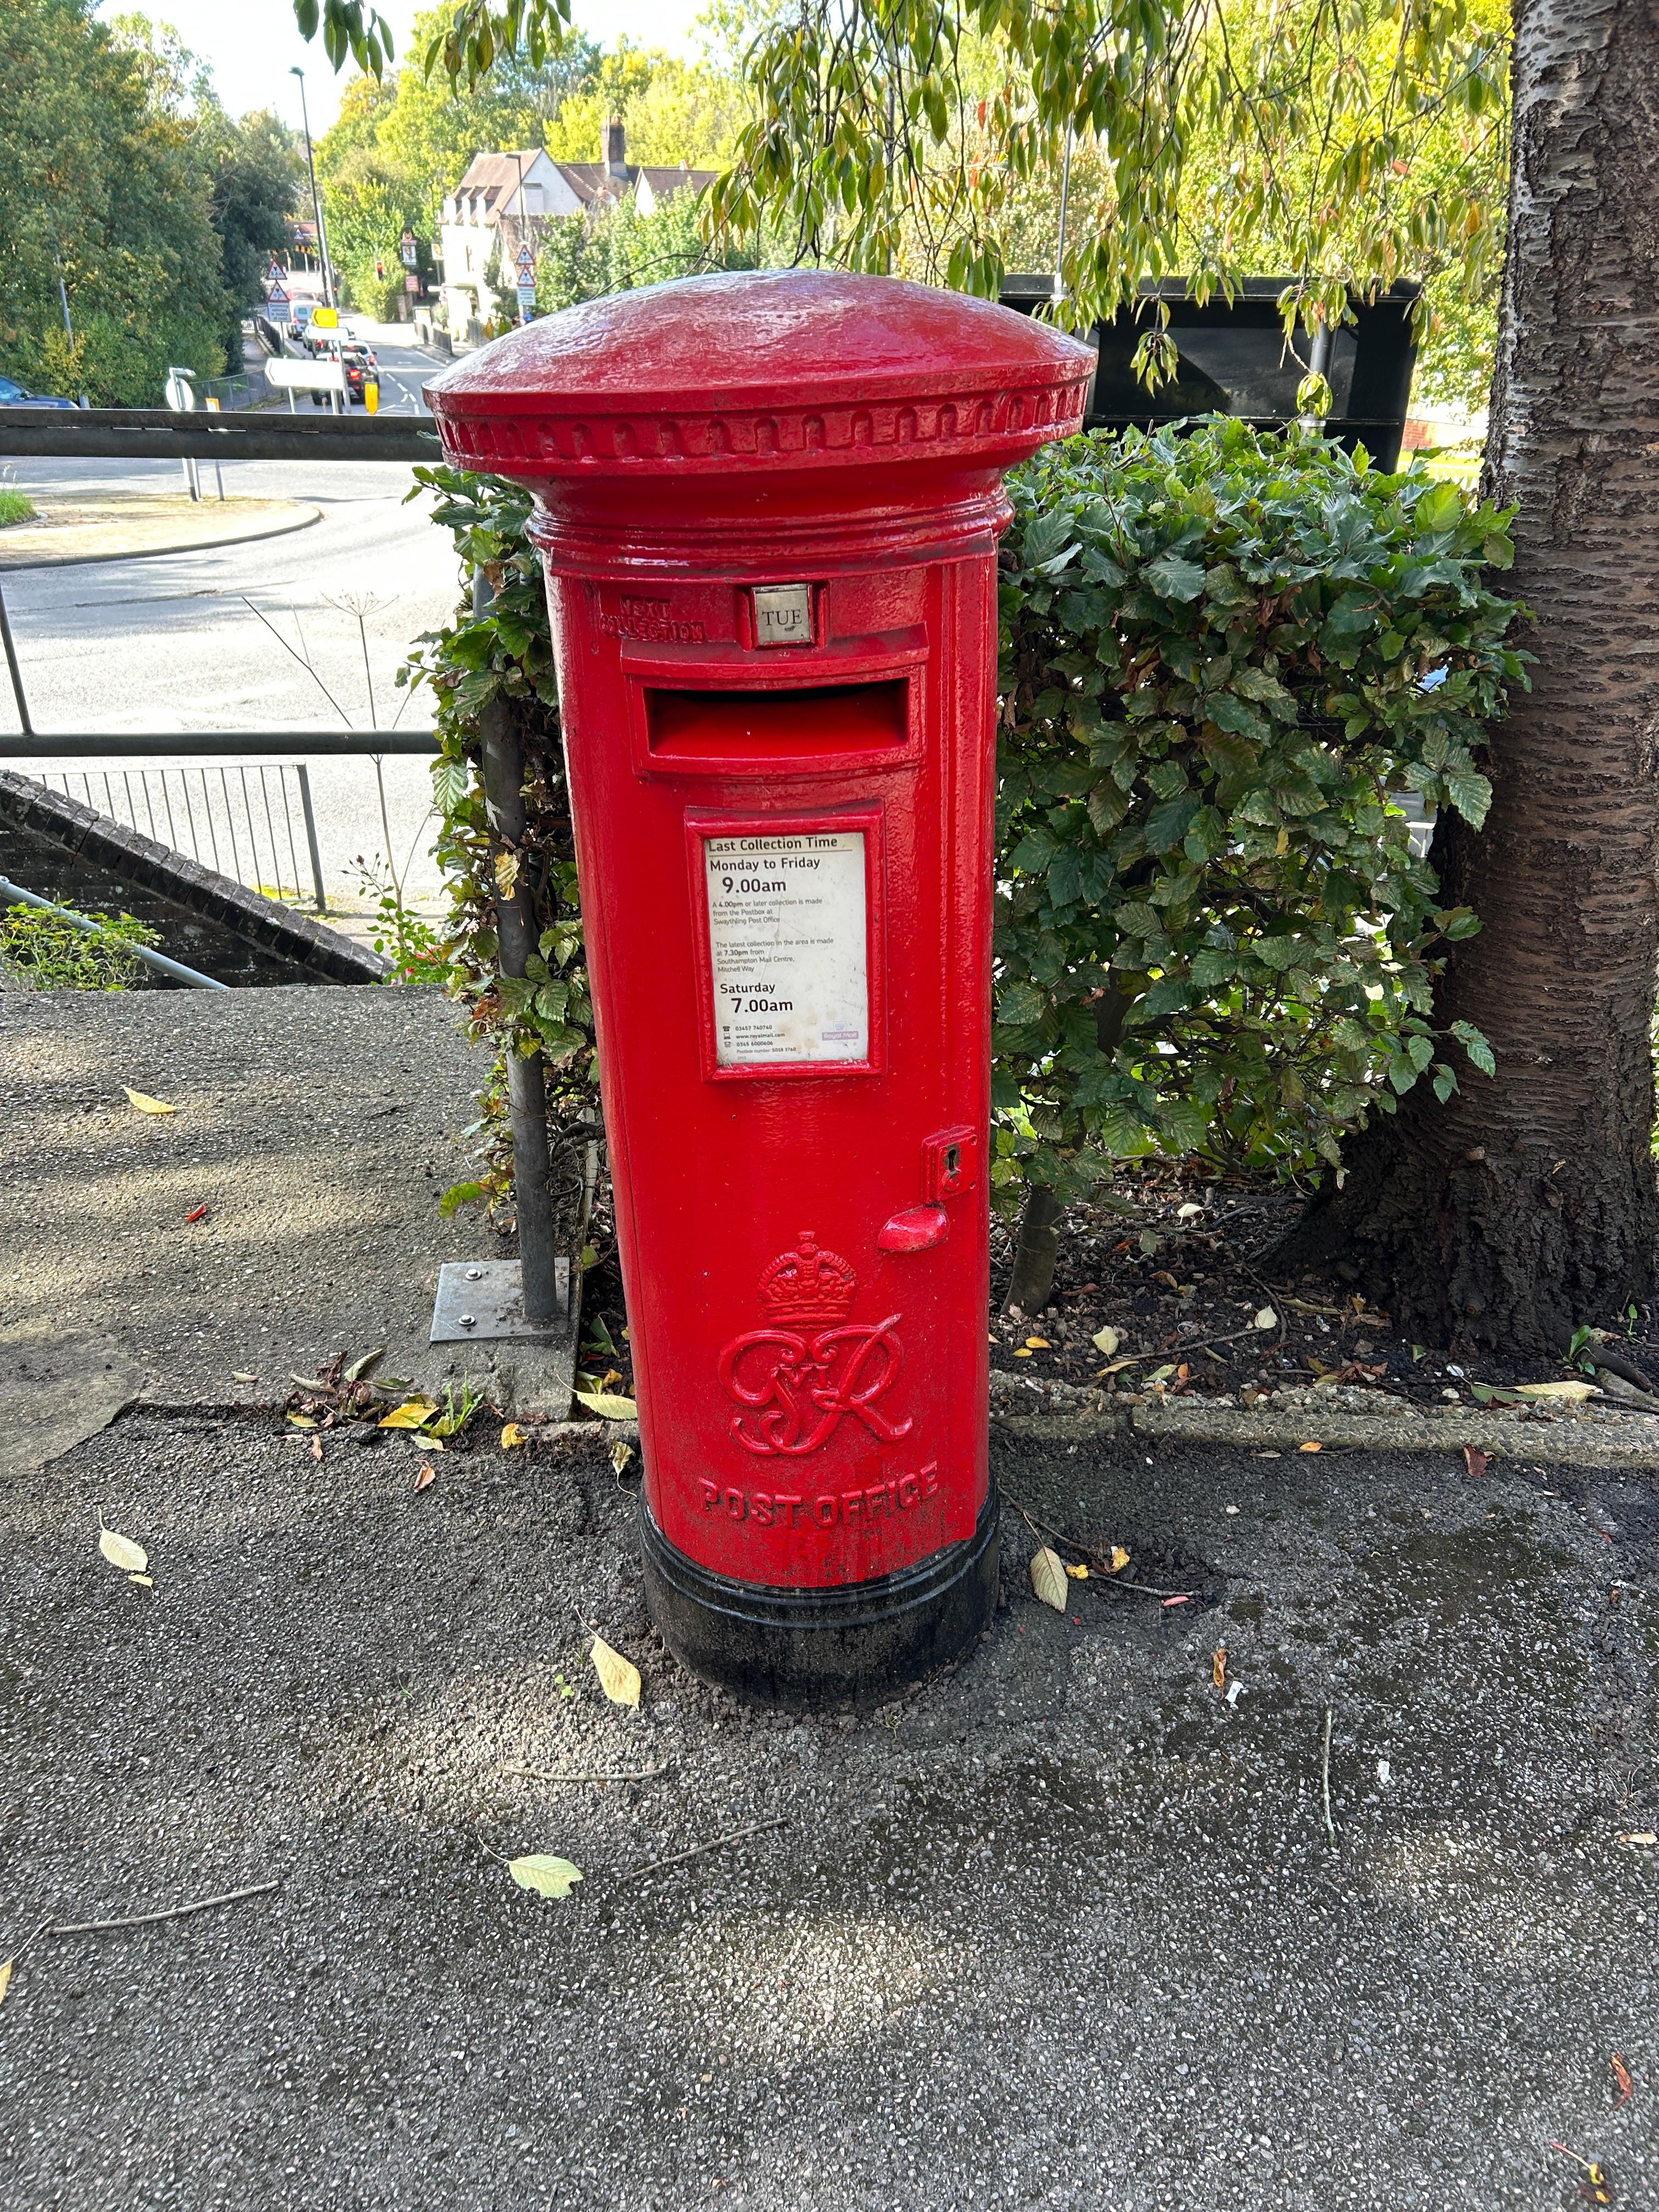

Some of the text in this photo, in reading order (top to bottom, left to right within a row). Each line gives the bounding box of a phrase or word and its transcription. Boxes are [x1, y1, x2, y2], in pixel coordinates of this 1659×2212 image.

[620, 595, 671, 619] NEXT
[762, 609, 803, 627] TUE
[600, 614, 707, 644] COLLECTION
[708, 836, 838, 852] Last Collection Time
[710, 857, 821, 872] Monday to Friday
[722, 876, 787, 894] 9.00am
[714, 917, 747, 927] Swaythling
[742, 965, 755, 973] Way
[720, 982, 776, 994] Saturday
[731, 997, 793, 1013] 7.00am
[698, 1460, 939, 1529] POST OFFICE
